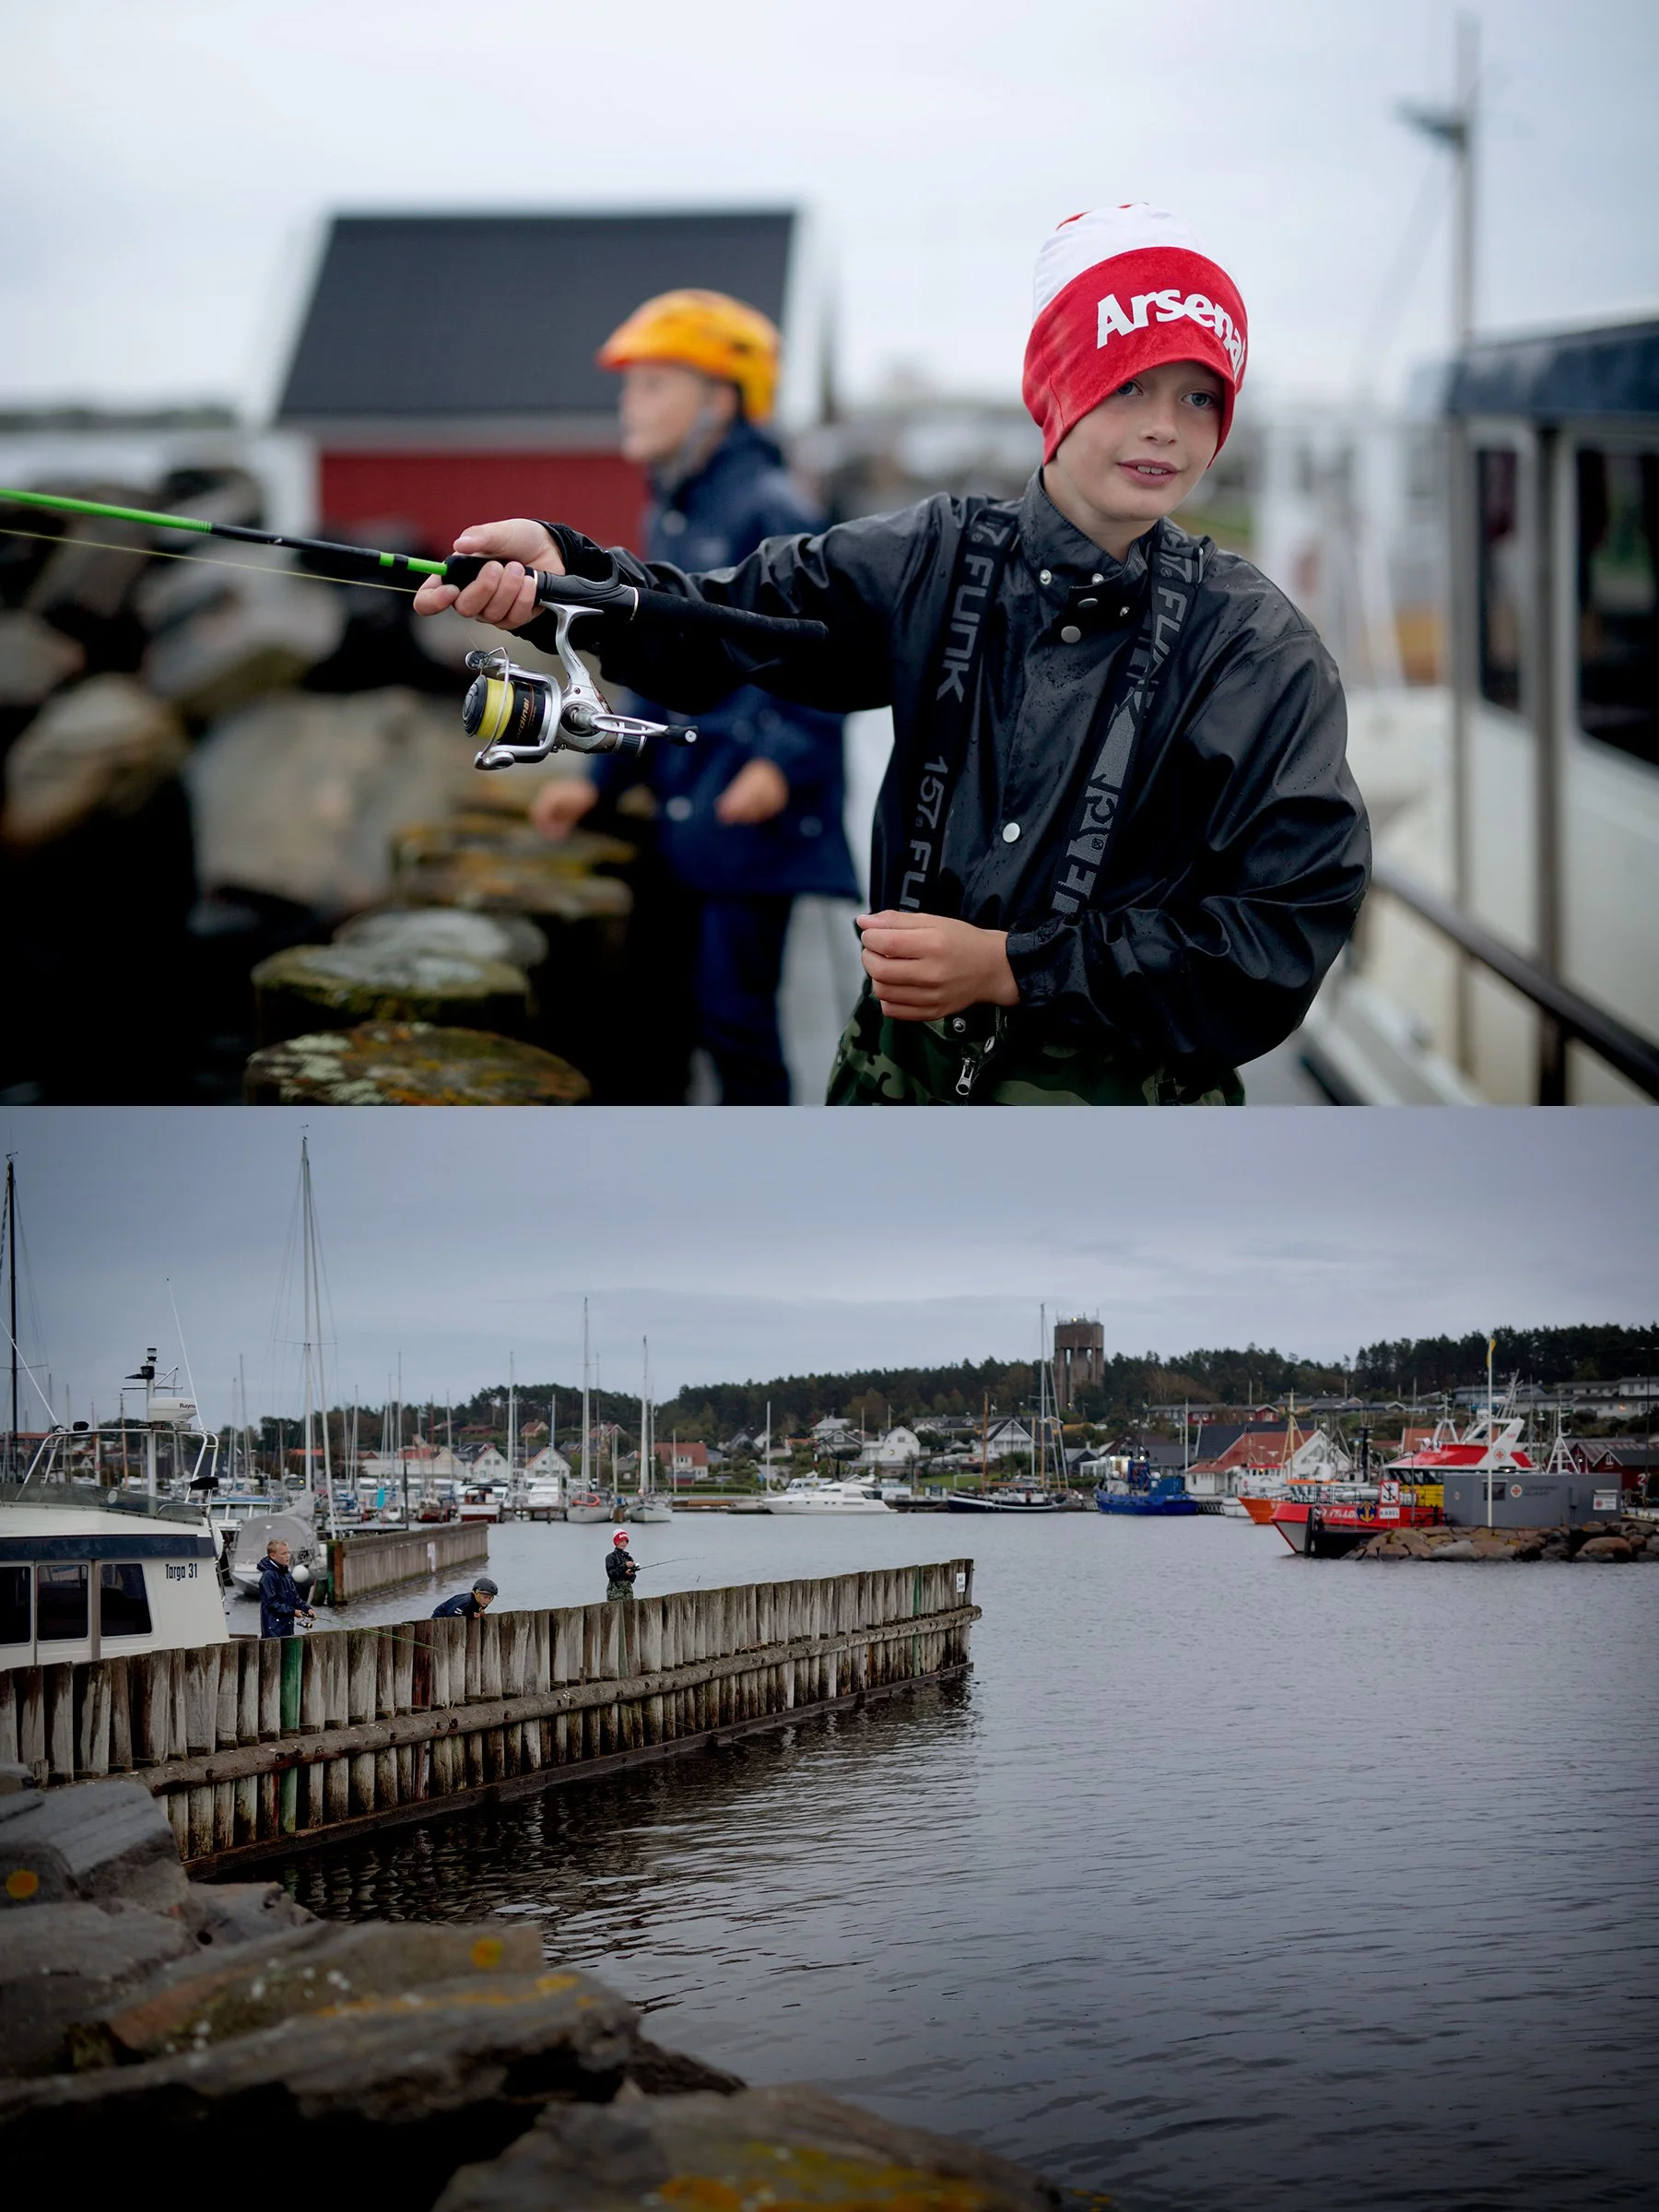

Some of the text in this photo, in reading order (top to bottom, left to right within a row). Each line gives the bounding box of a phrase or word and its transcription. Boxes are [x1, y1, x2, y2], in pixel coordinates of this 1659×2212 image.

[1097, 289, 1246, 381] Arsenal
[935, 553, 994, 703] FUNK
[899, 755, 948, 912] 157 FU
[165, 1562, 197, 1582] Targa 31
